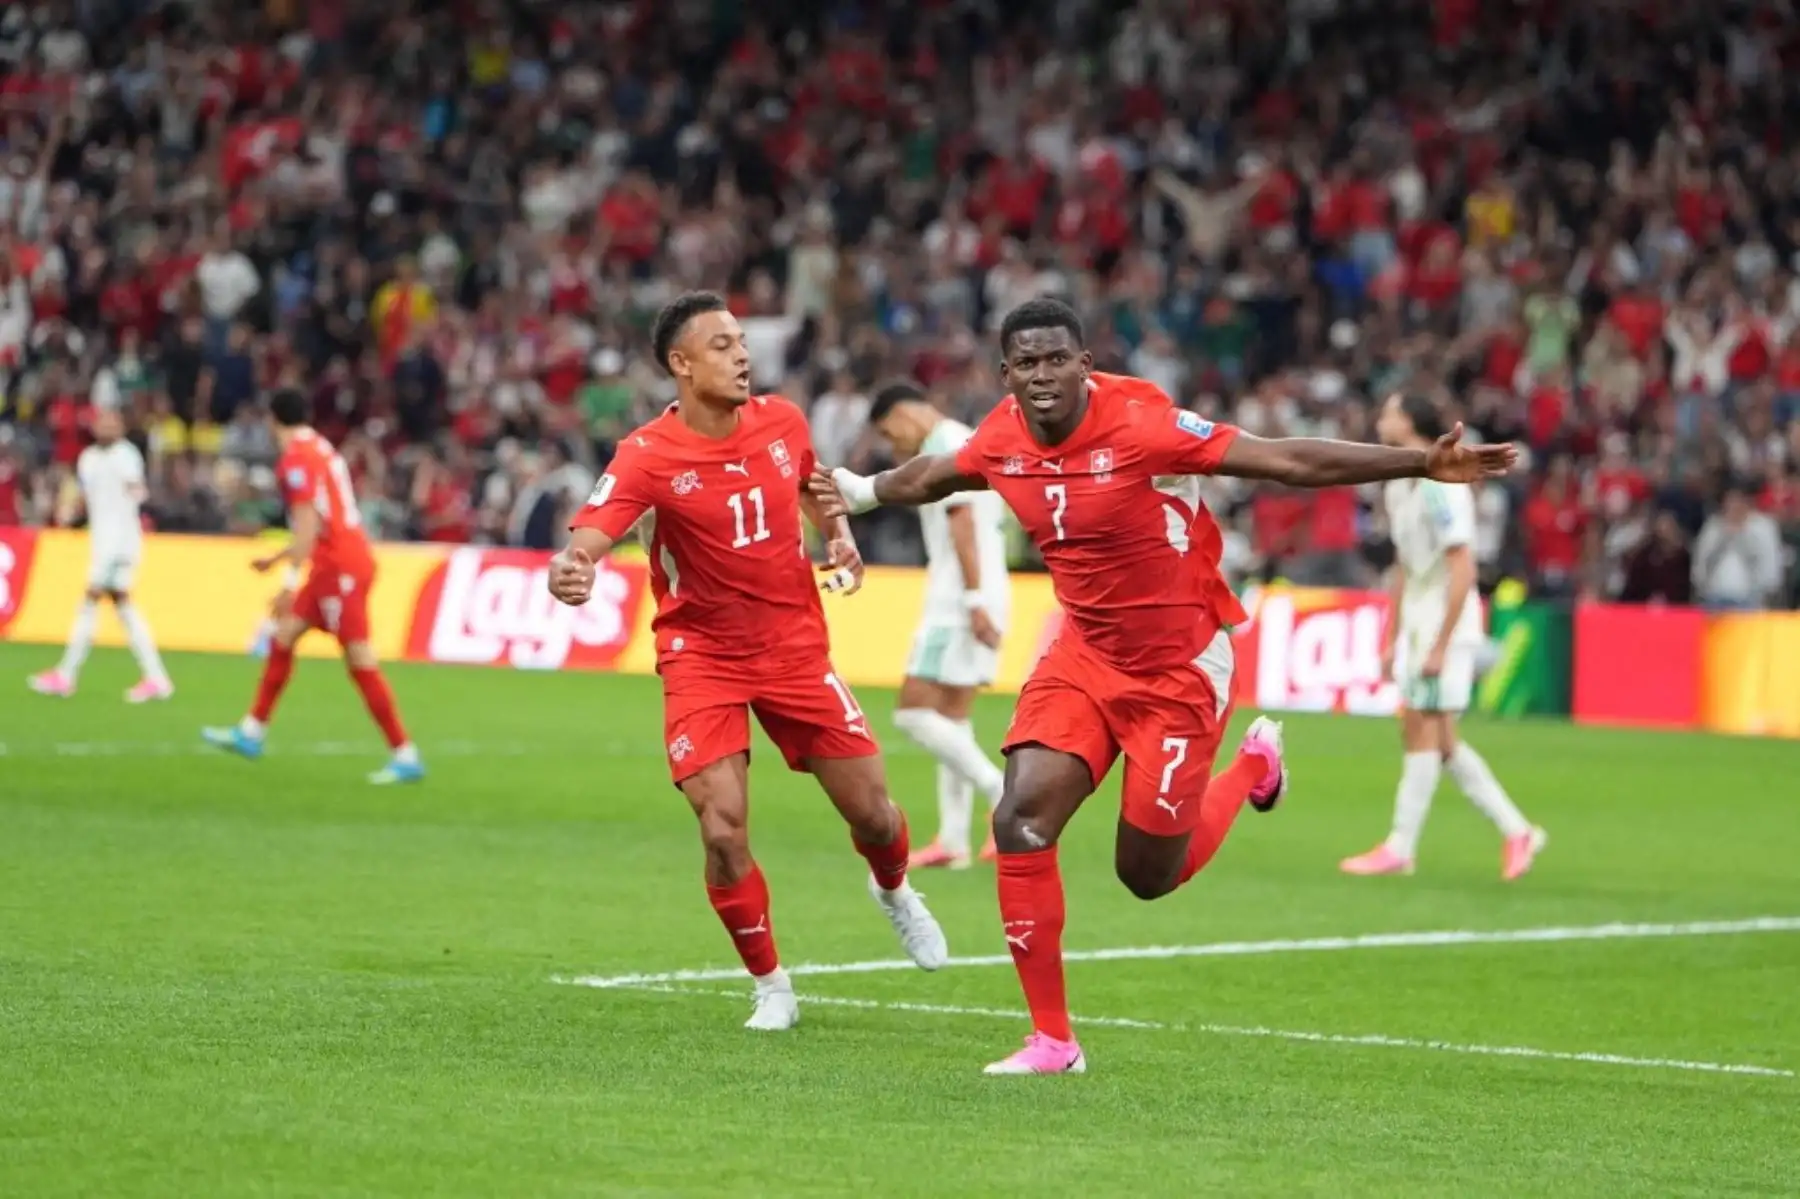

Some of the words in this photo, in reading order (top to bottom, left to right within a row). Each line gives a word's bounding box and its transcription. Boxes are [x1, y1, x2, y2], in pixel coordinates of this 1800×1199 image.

[726, 486, 771, 549] 11
[1044, 484, 1067, 541] 7
[823, 671, 864, 723] 1
[1159, 736, 1189, 794] 7
